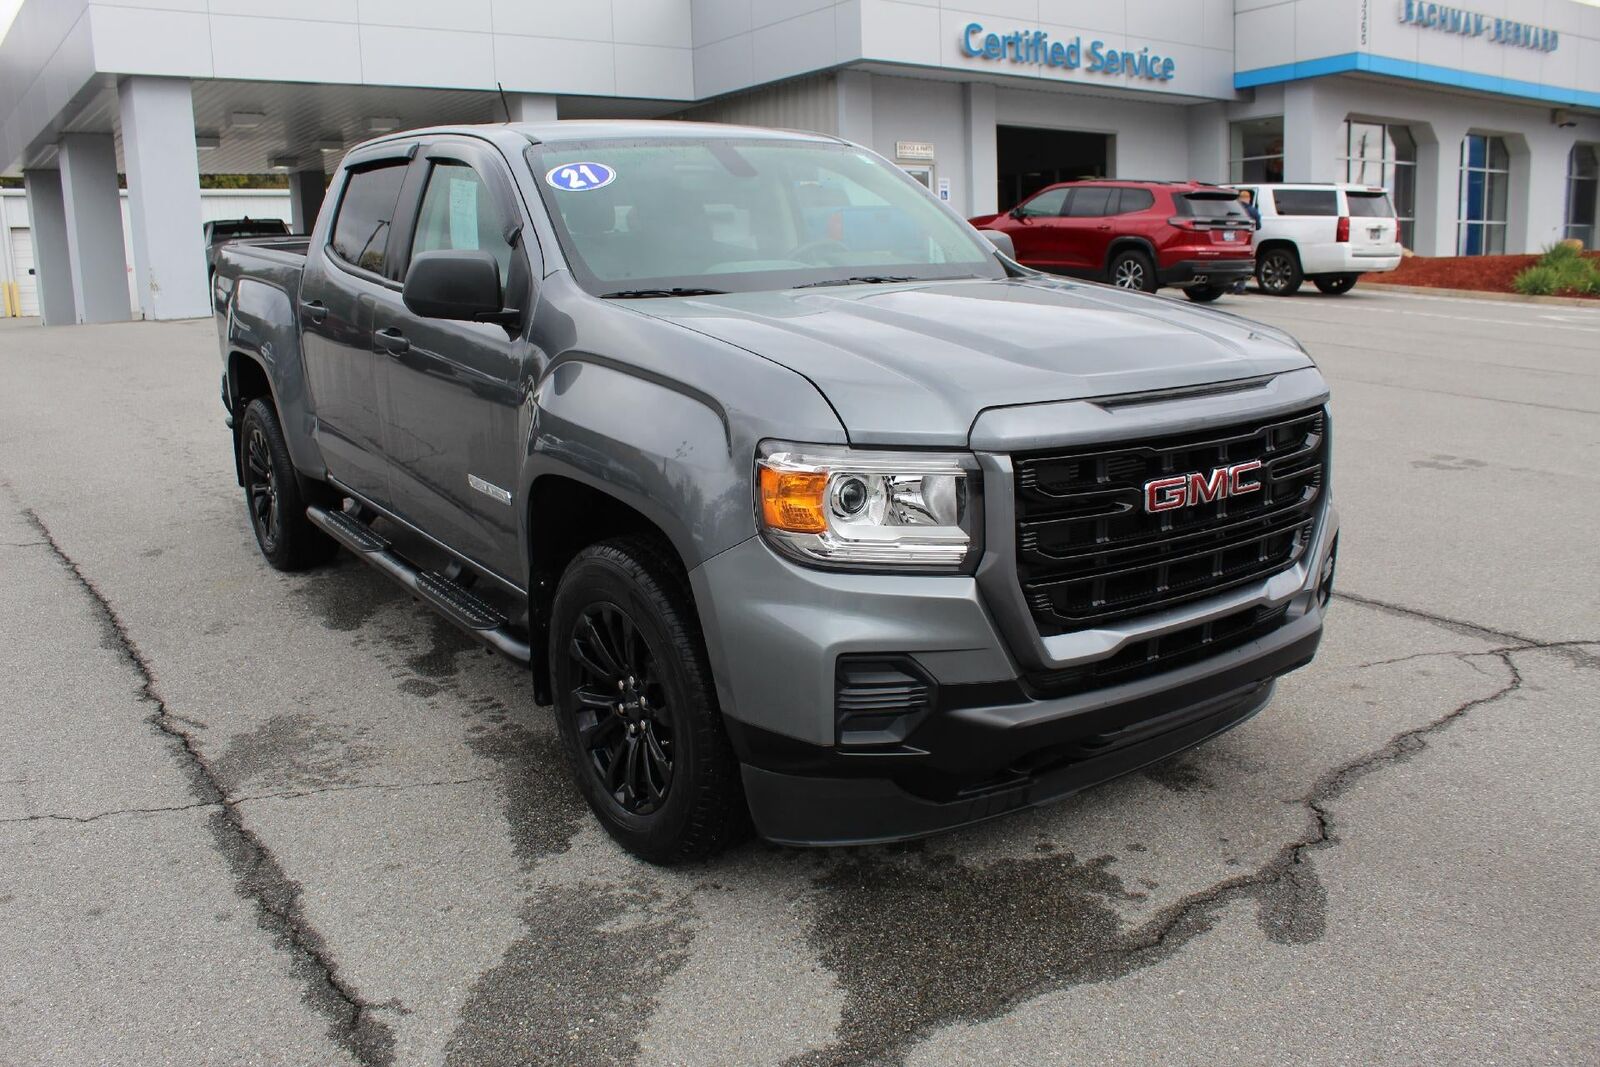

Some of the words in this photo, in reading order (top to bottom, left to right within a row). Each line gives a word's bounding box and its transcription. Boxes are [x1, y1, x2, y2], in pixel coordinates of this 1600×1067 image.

[963, 22, 1081, 69] Certified
[1089, 41, 1175, 80] Service
[560, 164, 600, 189] 21
[1144, 460, 1262, 513] GMC
